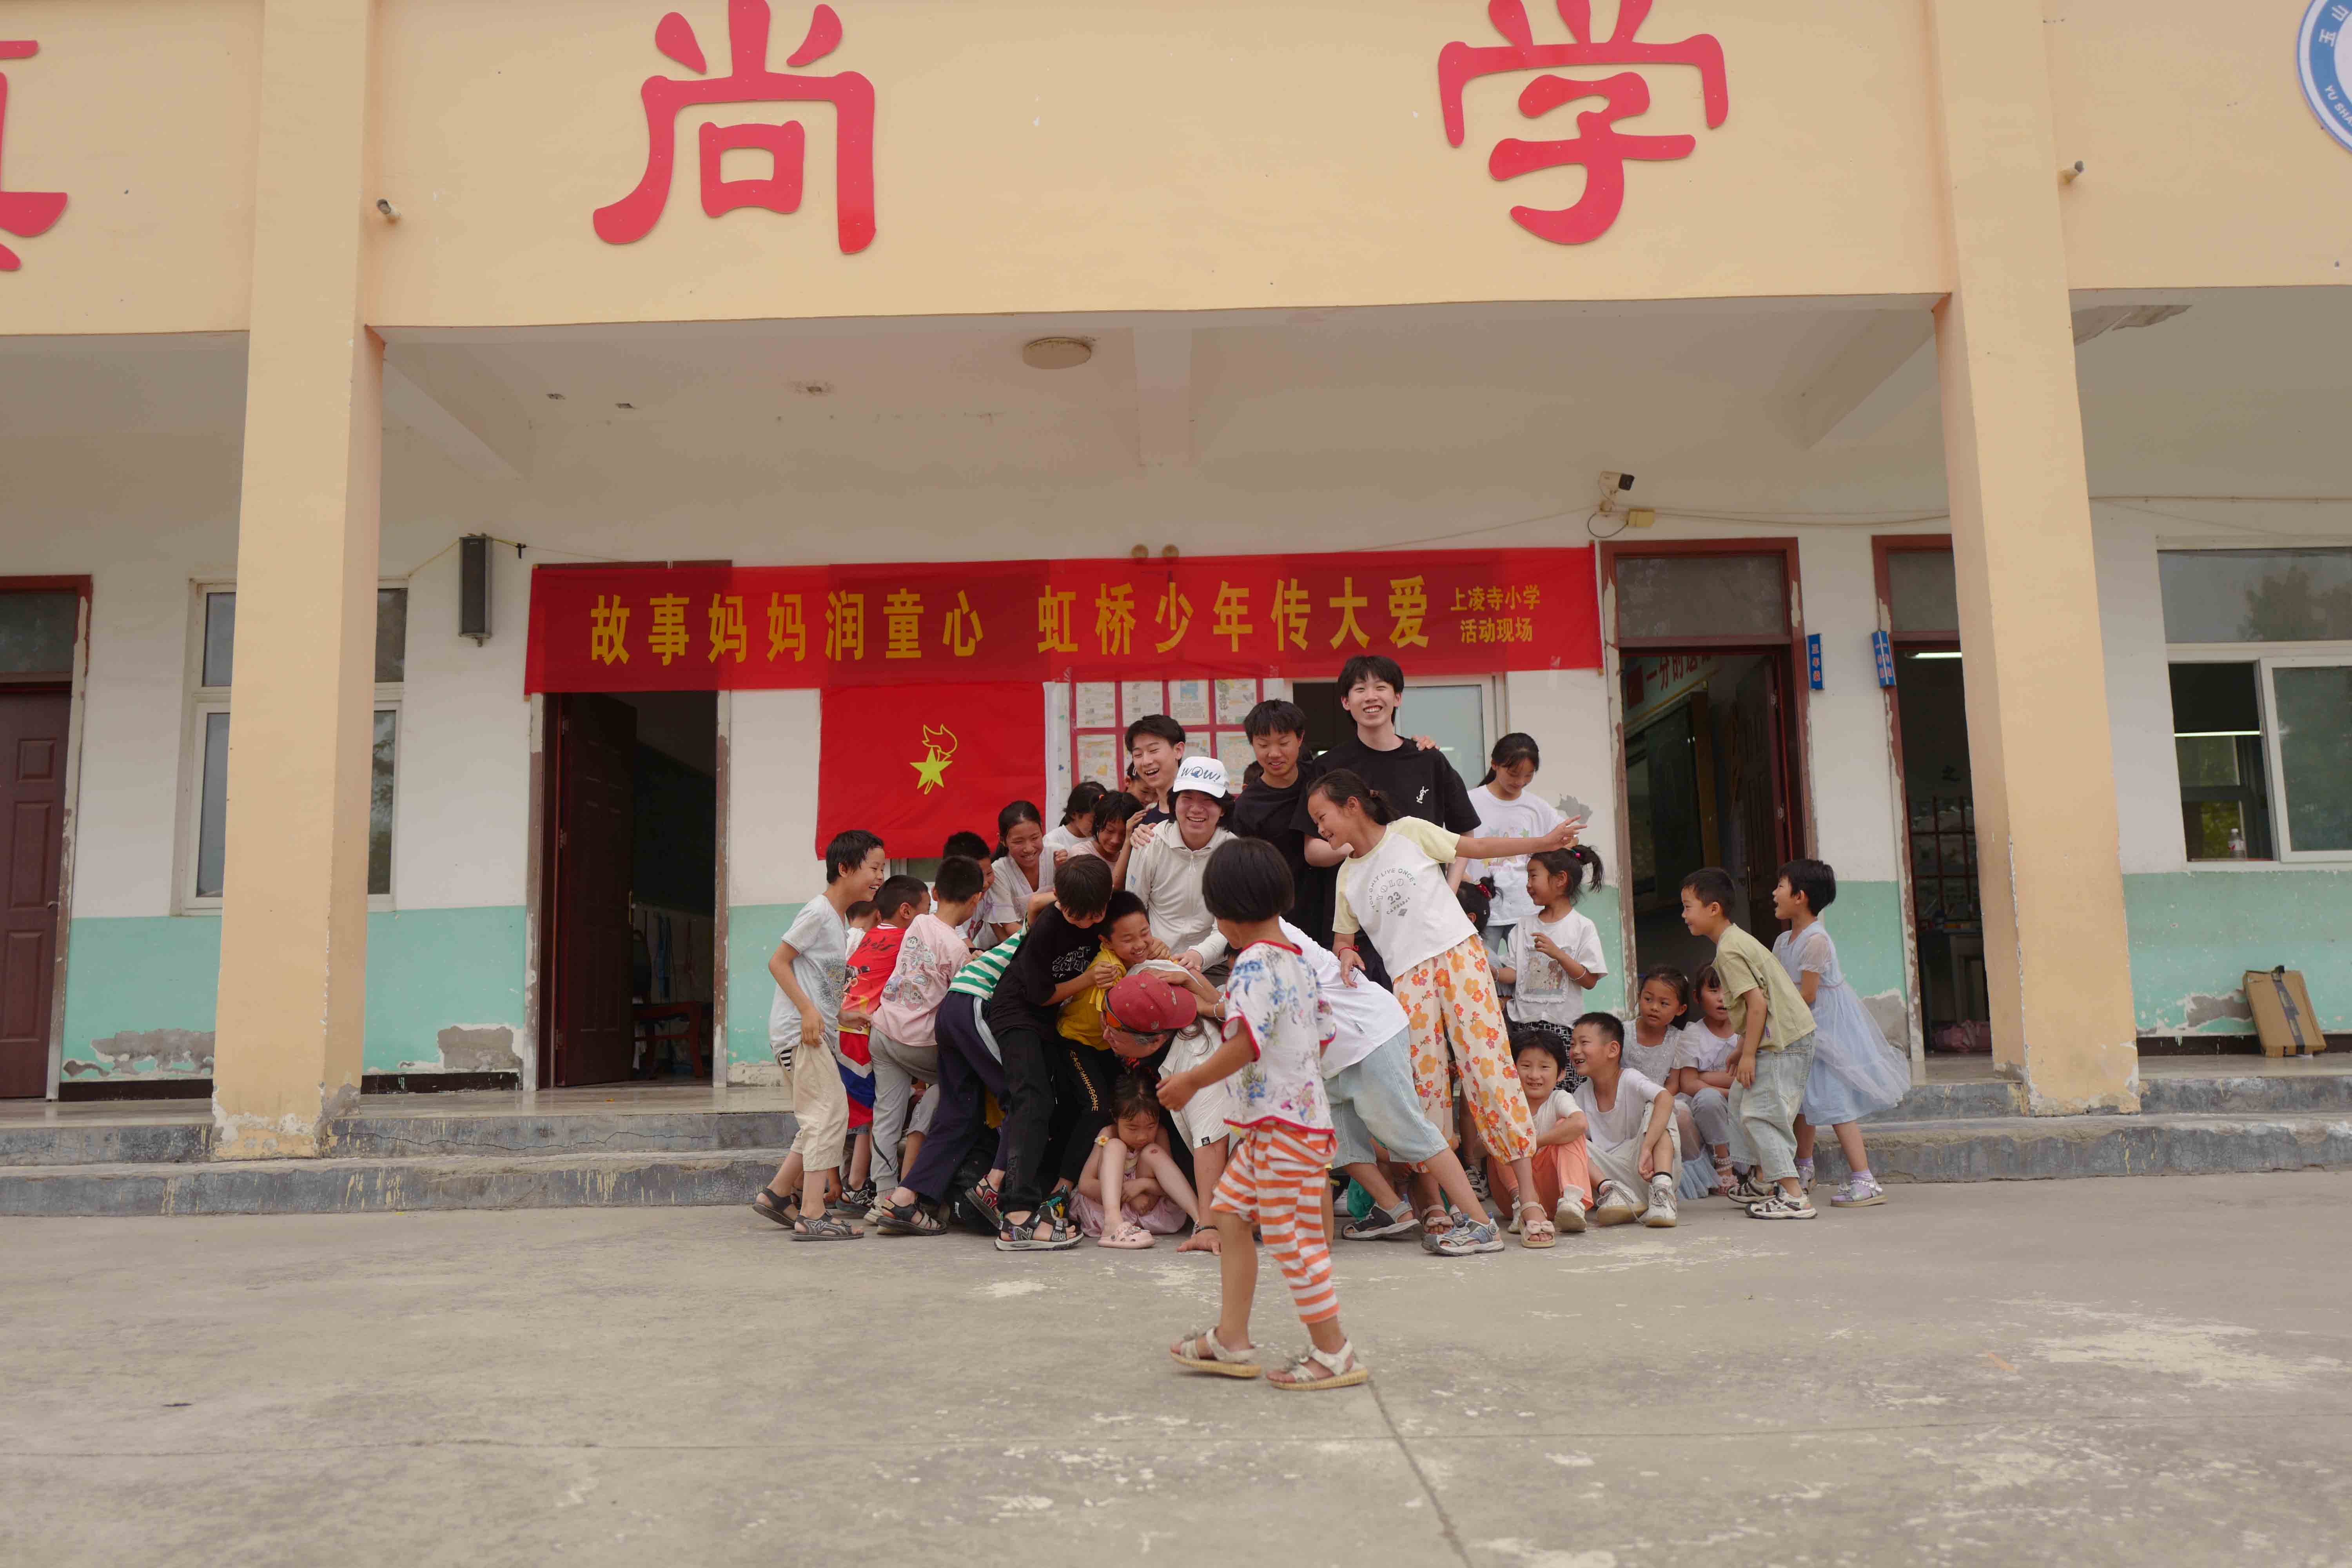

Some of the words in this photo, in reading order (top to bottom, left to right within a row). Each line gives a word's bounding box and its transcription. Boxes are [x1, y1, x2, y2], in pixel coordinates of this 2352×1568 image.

[2325, 85, 2338, 100] YU
[593, 0, 877, 254] 尚
[1438, 0, 1729, 245] 学
[591, 588, 984, 666] 故事妈妈润童心
[1037, 575, 1429, 656] 虹桥少年传大爱
[1460, 617, 1533, 643] 活动现场
[1381, 868, 1396, 877] LIVE
[1398, 868, 1415, 882] ONCE
[1376, 878, 1404, 900] YOLO
[1387, 892, 1401, 905] 23
